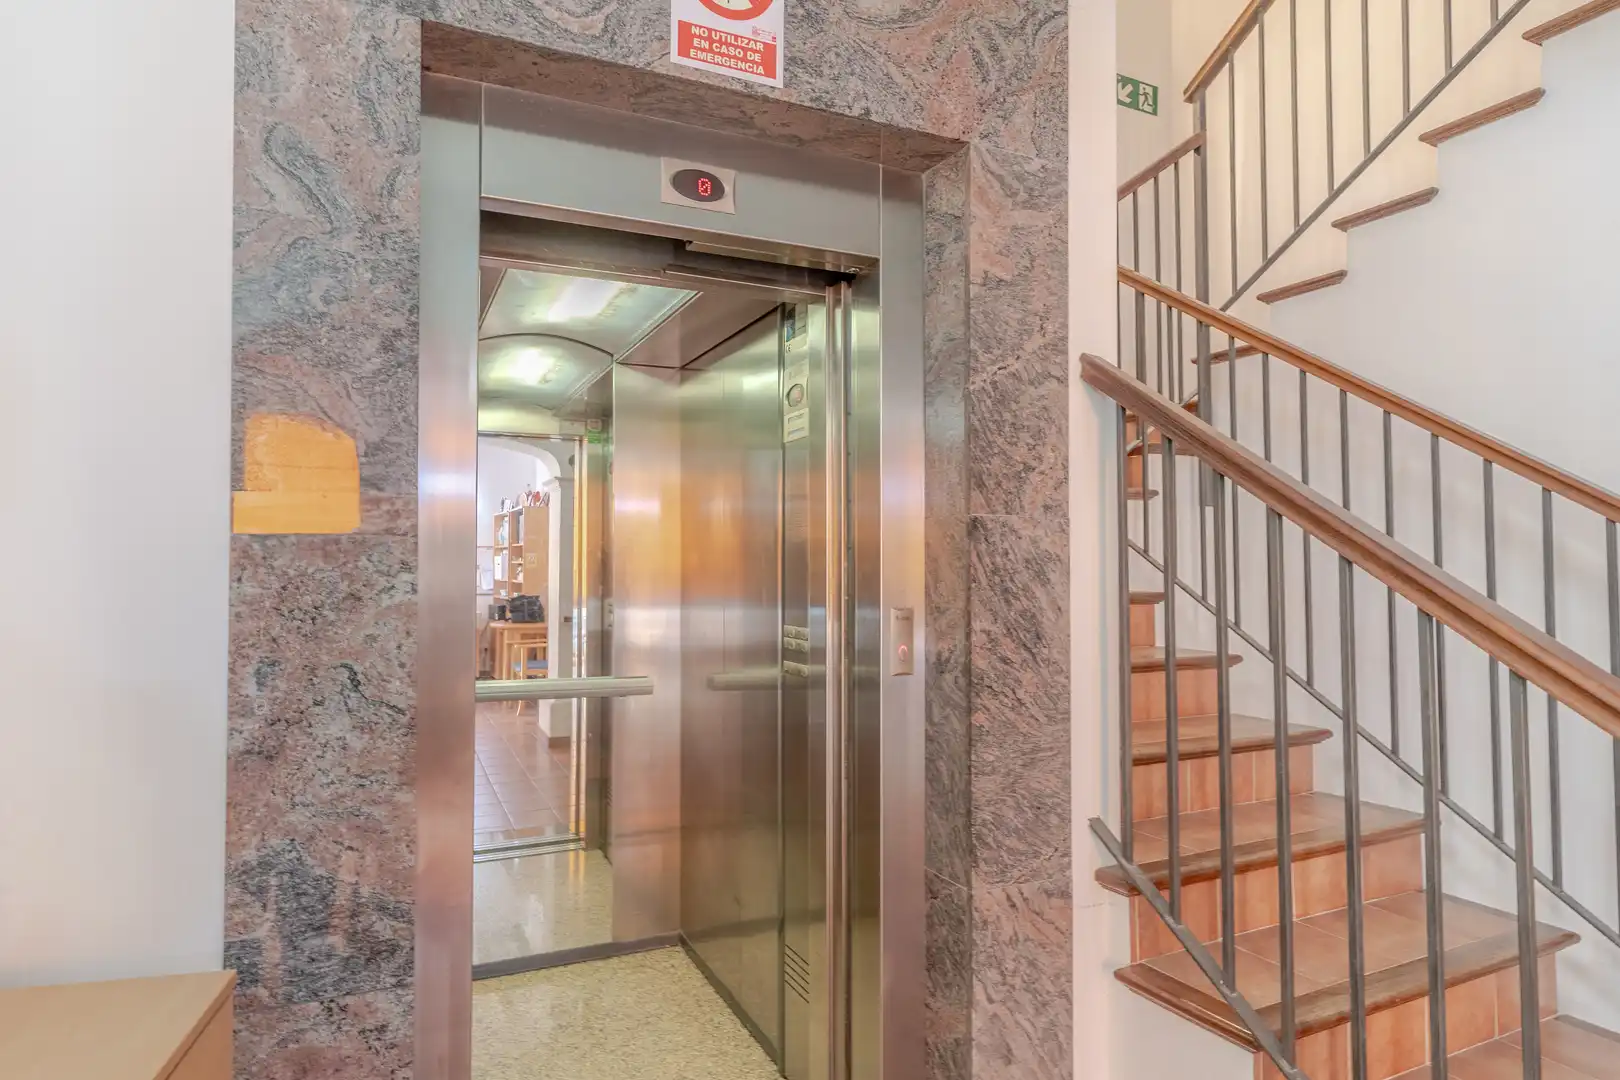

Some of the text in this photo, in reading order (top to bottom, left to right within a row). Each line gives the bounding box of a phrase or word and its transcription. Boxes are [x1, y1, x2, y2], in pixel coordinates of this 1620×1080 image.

[691, 25, 708, 37] NO
[712, 30, 764, 52] UTILIZAR
[693, 38, 762, 62] EN CASO DE
[690, 49, 765, 75] EMERGENCIA
